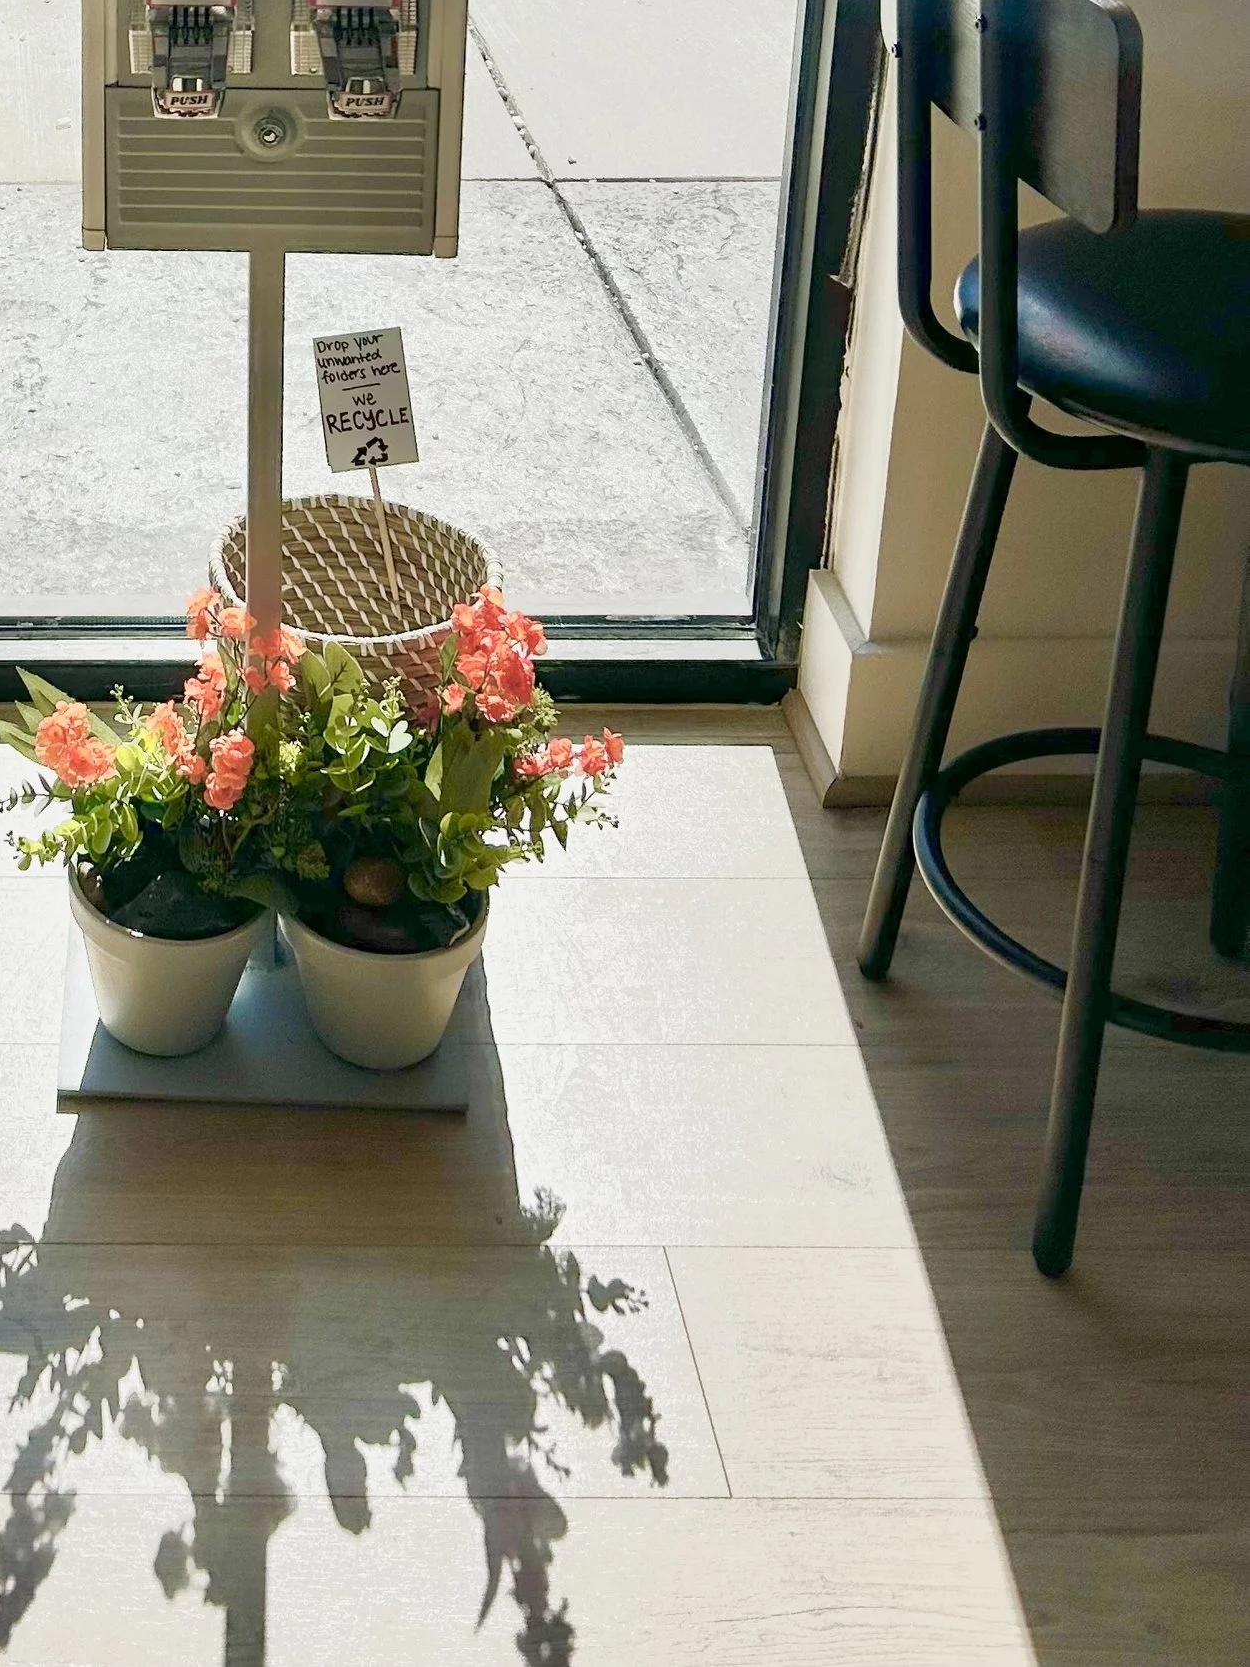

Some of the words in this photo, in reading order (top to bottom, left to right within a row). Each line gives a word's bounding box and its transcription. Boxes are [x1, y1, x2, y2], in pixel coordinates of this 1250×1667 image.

[171, 94, 208, 107] PUSH
[345, 95, 385, 108] PUSH
[316, 340, 349, 354] Drop
[353, 334, 384, 351] your
[317, 348, 382, 369] unwanted
[322, 368, 366, 384] folders
[371, 362, 401, 376] here
[326, 407, 410, 434] RECYCLE
